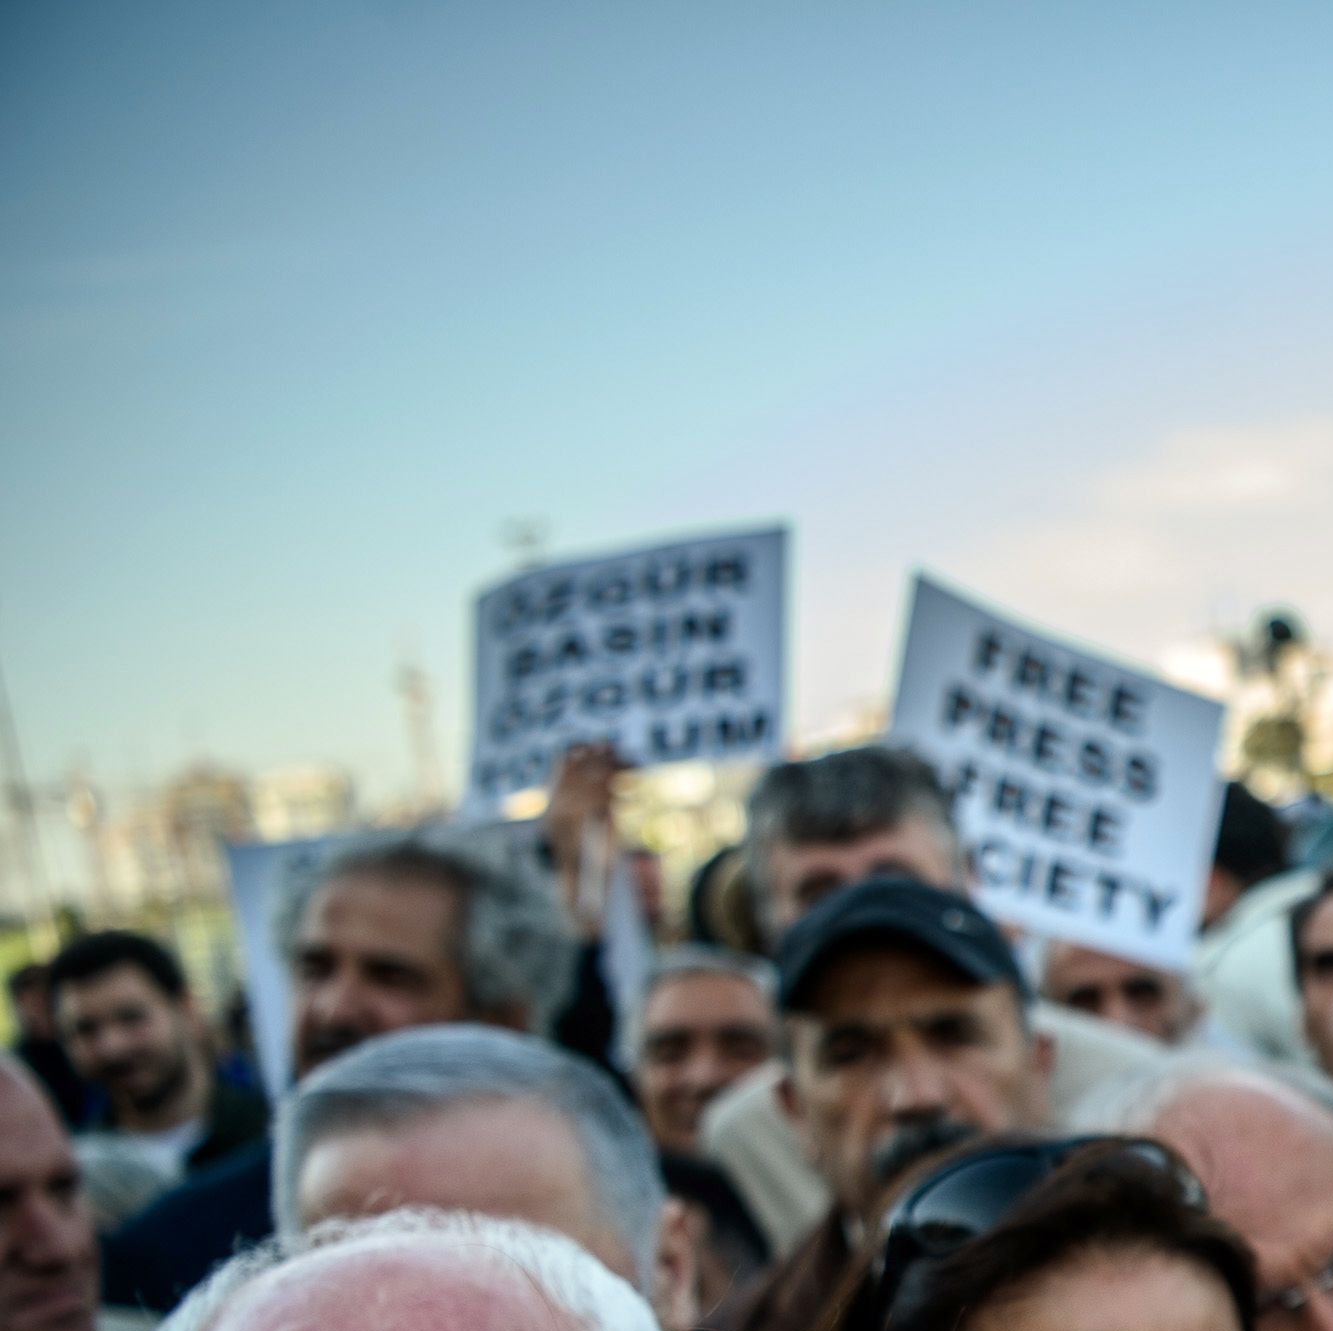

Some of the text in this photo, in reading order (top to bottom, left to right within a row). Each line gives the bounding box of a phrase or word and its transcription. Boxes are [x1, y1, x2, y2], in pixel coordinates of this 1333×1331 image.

[972, 625, 1146, 736] FREE
[942, 682, 1160, 806] PRESS
[966, 836, 1182, 932] CIETY
